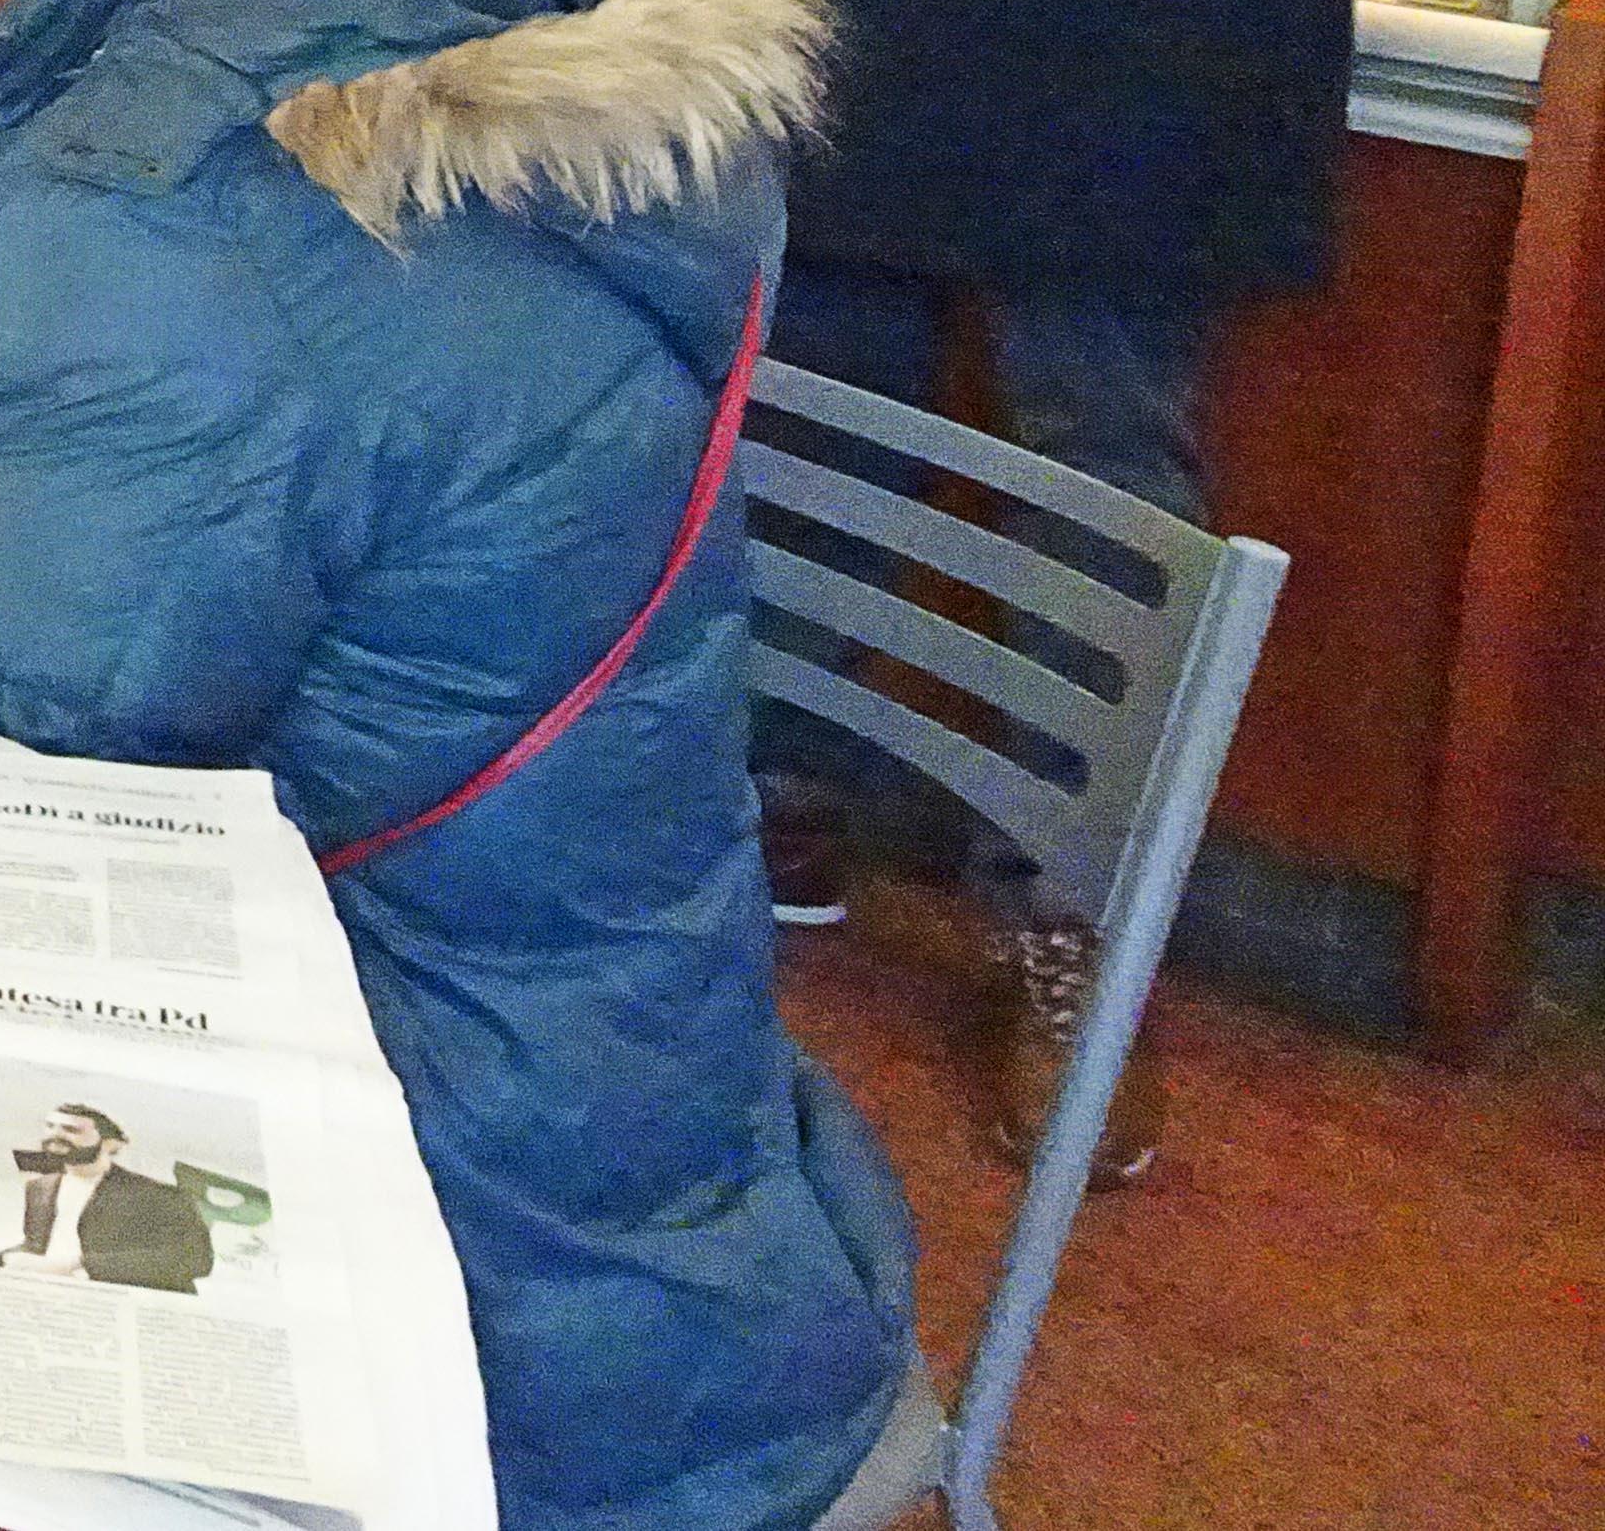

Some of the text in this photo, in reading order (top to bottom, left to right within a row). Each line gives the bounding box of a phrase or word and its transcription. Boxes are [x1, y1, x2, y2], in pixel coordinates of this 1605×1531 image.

[66, 809, 86, 822] a
[93, 811, 227, 836] giudizio
[93, 999, 147, 1023] tra
[157, 1007, 209, 1032] Pd
